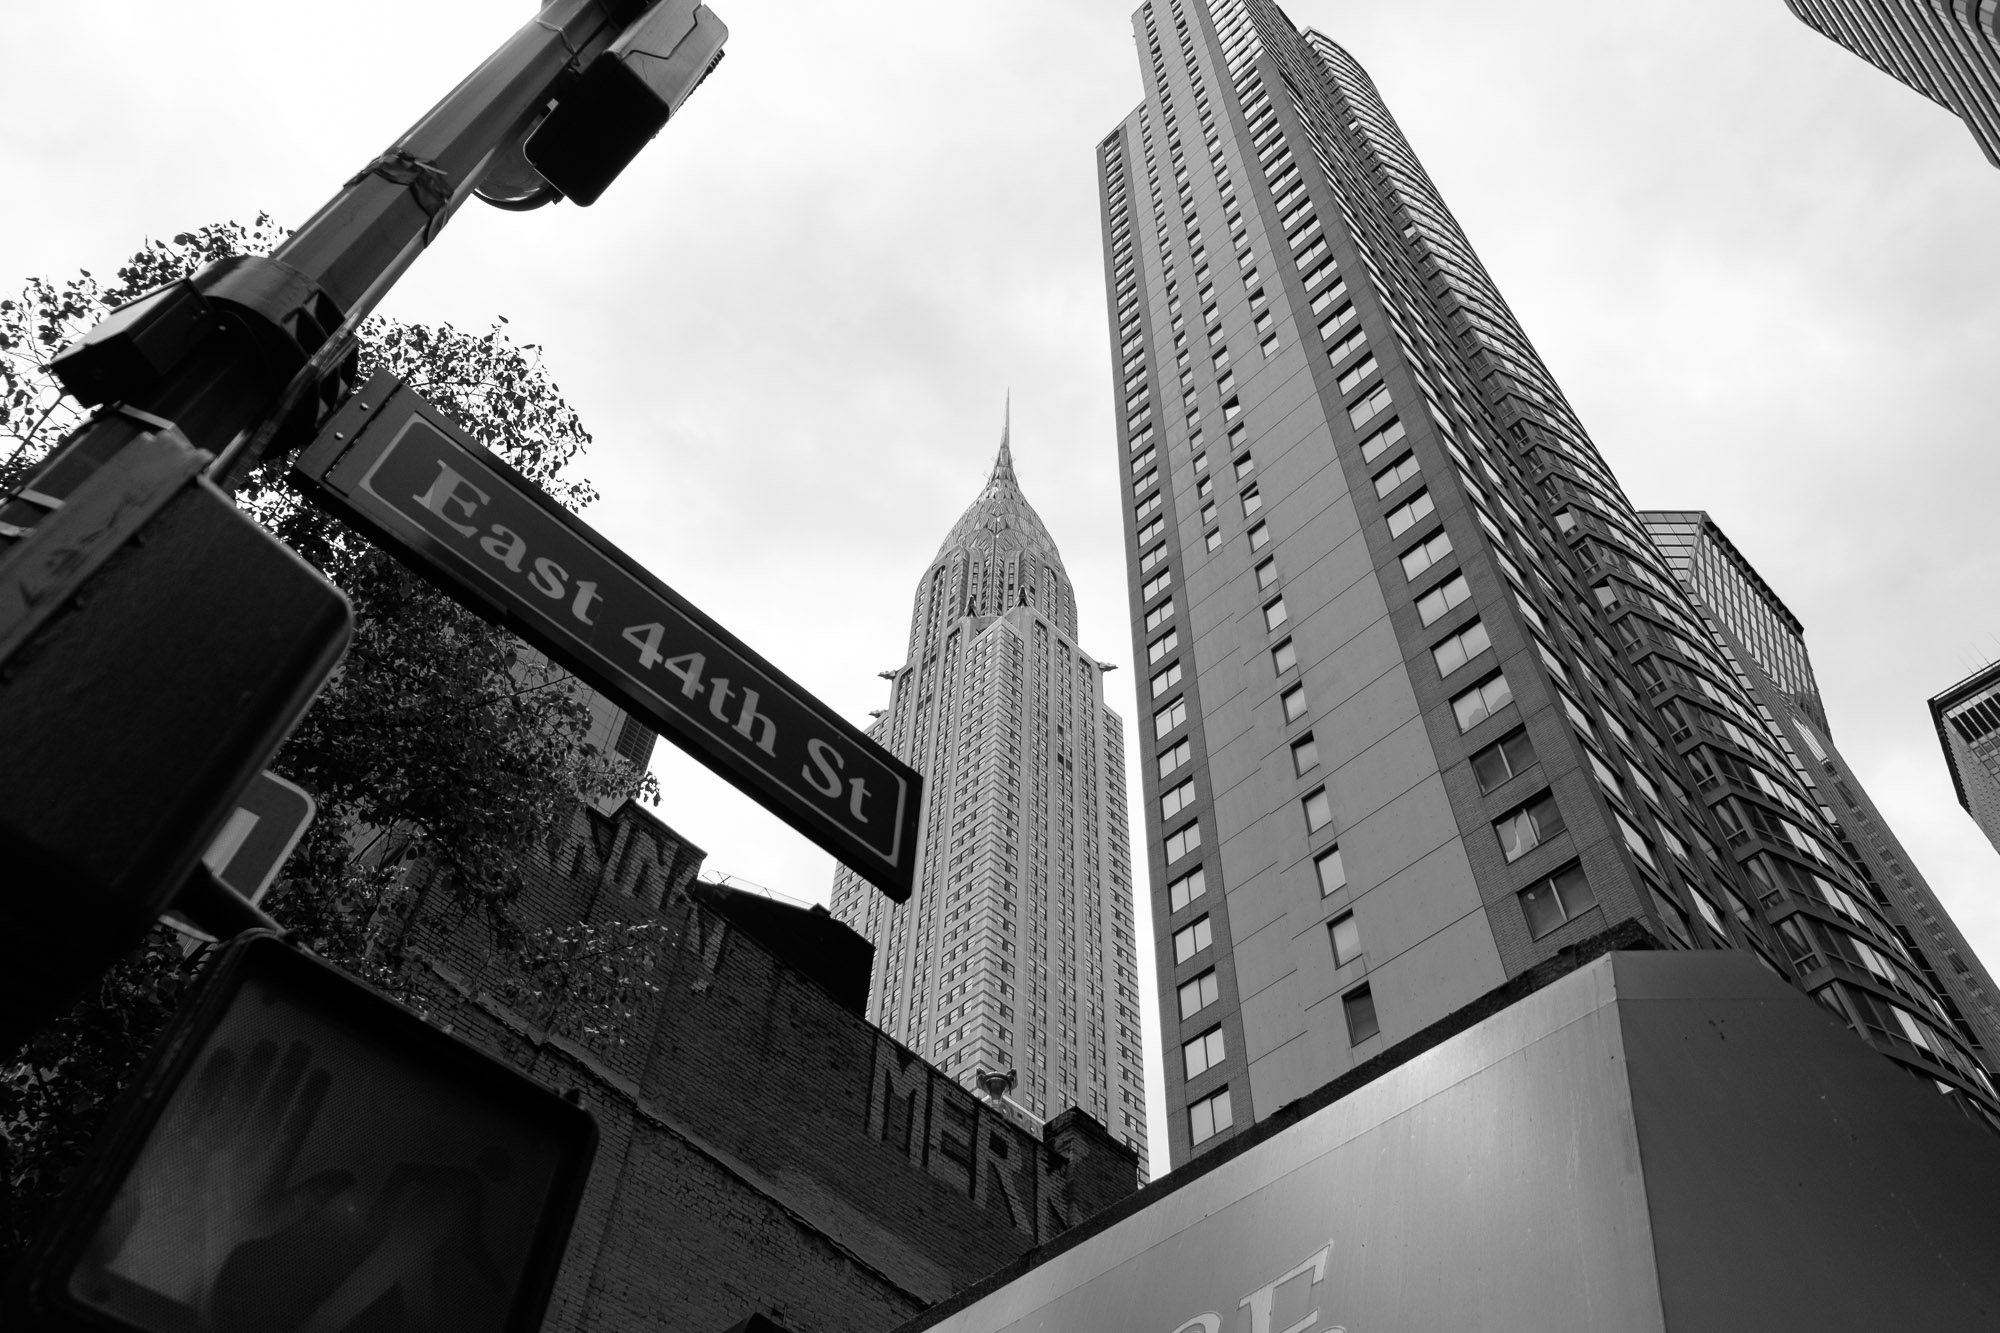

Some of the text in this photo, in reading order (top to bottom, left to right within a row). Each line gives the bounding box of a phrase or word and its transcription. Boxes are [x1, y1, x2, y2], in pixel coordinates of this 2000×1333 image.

[412, 459, 873, 824] East 44th St
